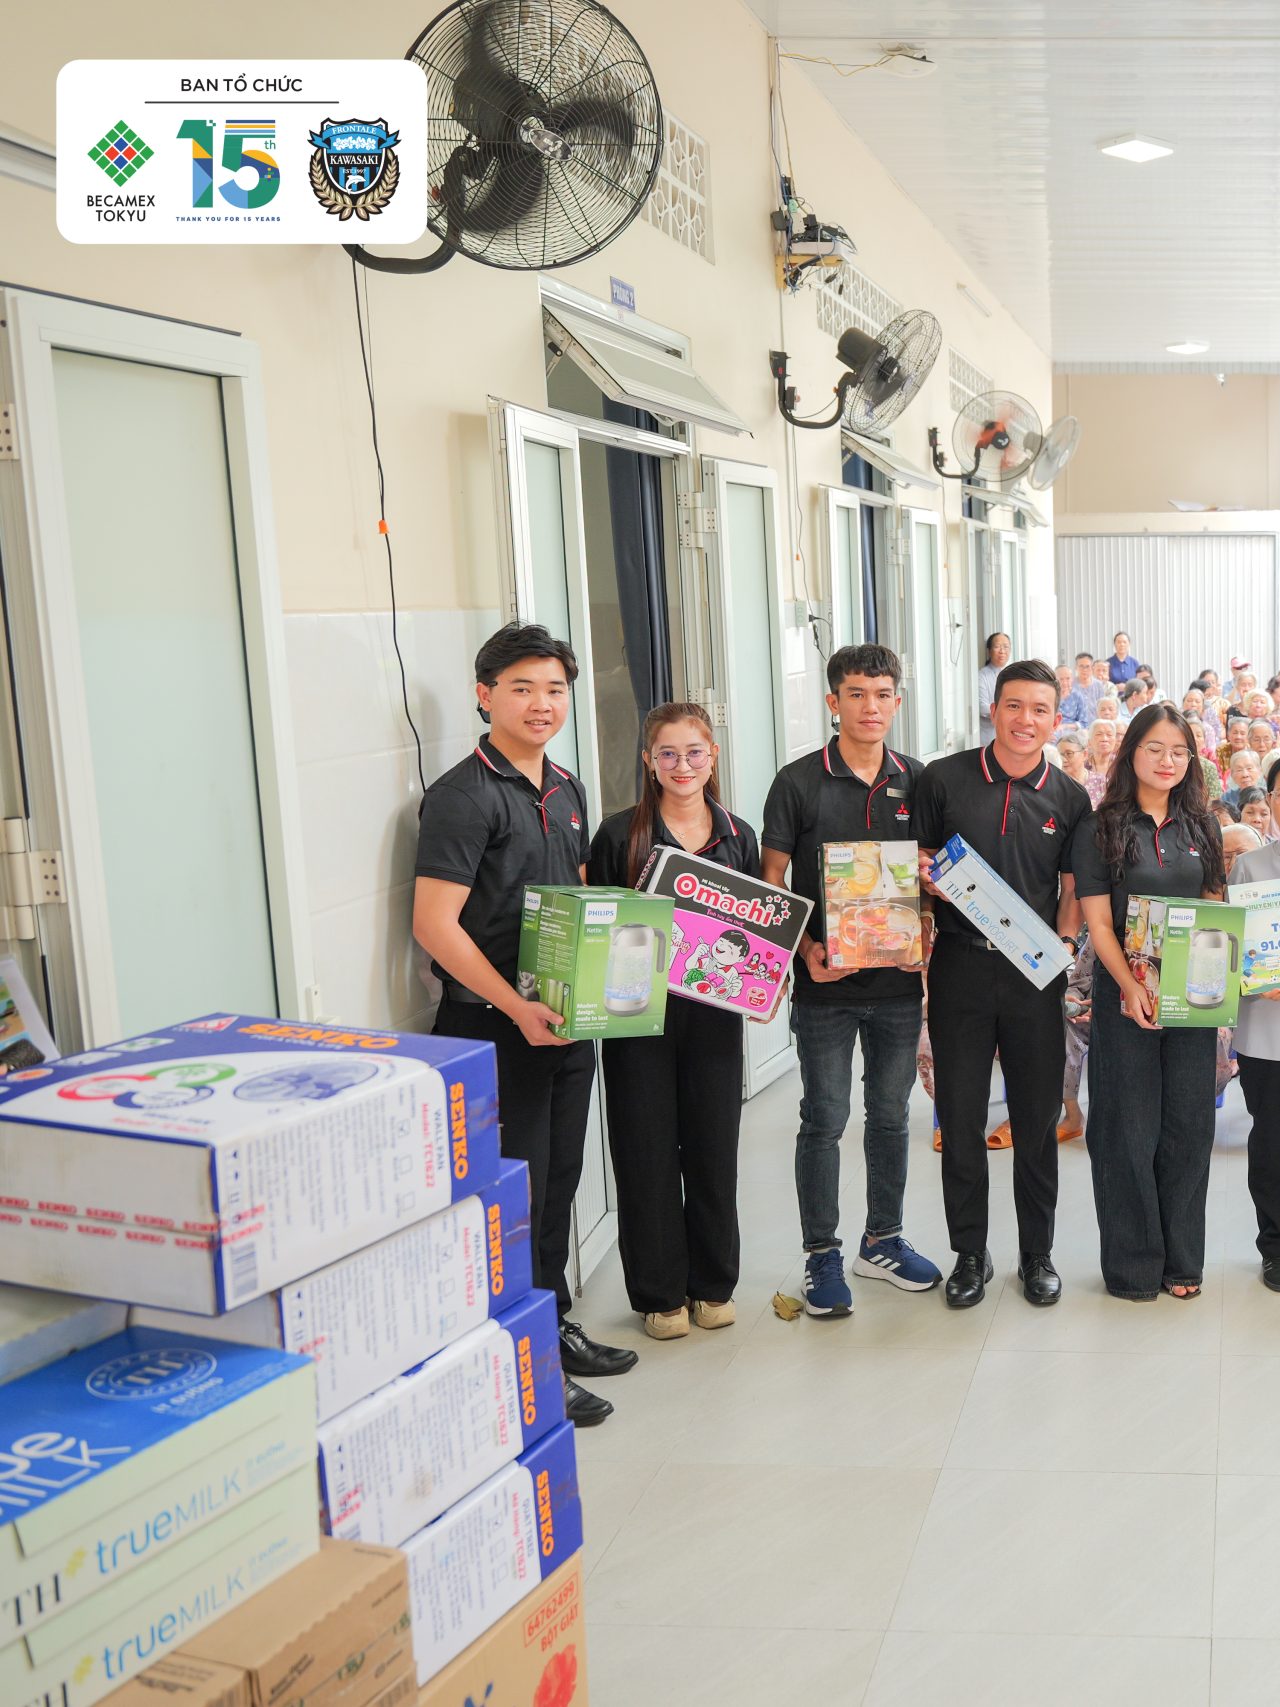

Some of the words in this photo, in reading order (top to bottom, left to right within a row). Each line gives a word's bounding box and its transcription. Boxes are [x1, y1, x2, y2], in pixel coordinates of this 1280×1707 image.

[674, 872, 776, 927] Omachi
[945, 880, 963, 900] TH
[236, 1023, 399, 1050] SENKO
[433, 1108, 444, 1143] WALL
[449, 1081, 469, 1181] SENKO
[423, 1143, 435, 1188] TC1622
[437, 1145, 445, 1171] FAN
[473, 1231, 481, 1264] WALL
[487, 1203, 504, 1297] SENKO
[518, 1335, 537, 1426] SENKO
[536, 1469, 555, 1558] SENKO
[2, 1573, 61, 1626] TH
